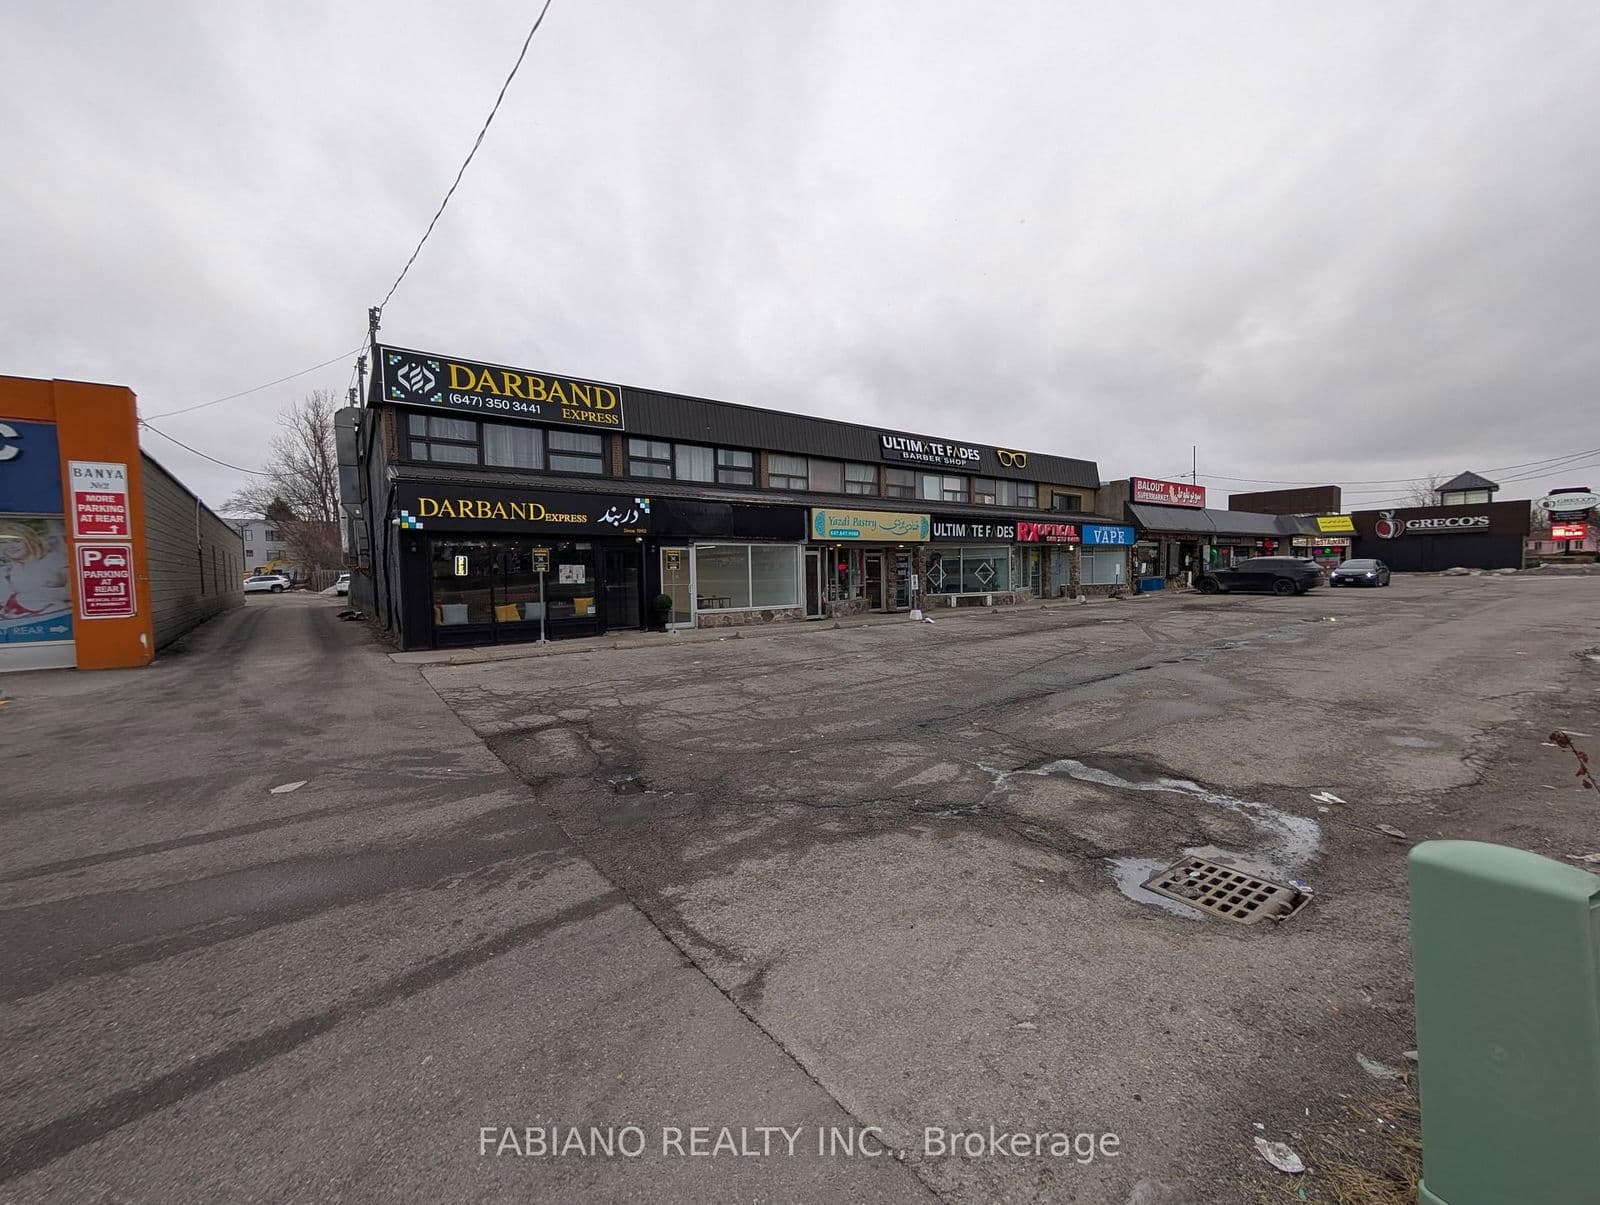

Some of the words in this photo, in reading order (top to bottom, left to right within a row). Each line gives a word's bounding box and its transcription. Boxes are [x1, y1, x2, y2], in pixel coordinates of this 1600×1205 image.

[447, 363, 617, 410] DARBAND
[449, 392, 483, 408] (647)
[486, 396, 510, 410] 350
[513, 400, 541, 415] 3441
[562, 408, 619, 425] EXPRESS
[902, 452, 942, 463] BARBER
[944, 457, 967, 466] SHOP
[73, 467, 124, 481] BANYA
[1137, 480, 1164, 492] BALOUT
[85, 494, 115, 504] MORE
[1137, 491, 1169, 501] SUPERMARKET
[78, 504, 125, 514] PARKING
[418, 497, 545, 521] DARBAND
[545, 514, 588, 523] EXPRESS
[80, 514, 93, 523] AT
[95, 514, 125, 523] REAR
[597, 506, 639, 527] دربند
[828, 515, 849, 526] Yazdi
[853, 517, 877, 531] Pastry
[1406, 515, 1490, 528] GRECO'S
[1039, 523, 1077, 536] OPTICAL
[1093, 530, 1125, 544] VAPE
[83, 570, 129, 579] PARKING
[100, 578, 112, 586] AT
[95, 585, 119, 594] REAR
[14, 626, 44, 634] REAR
